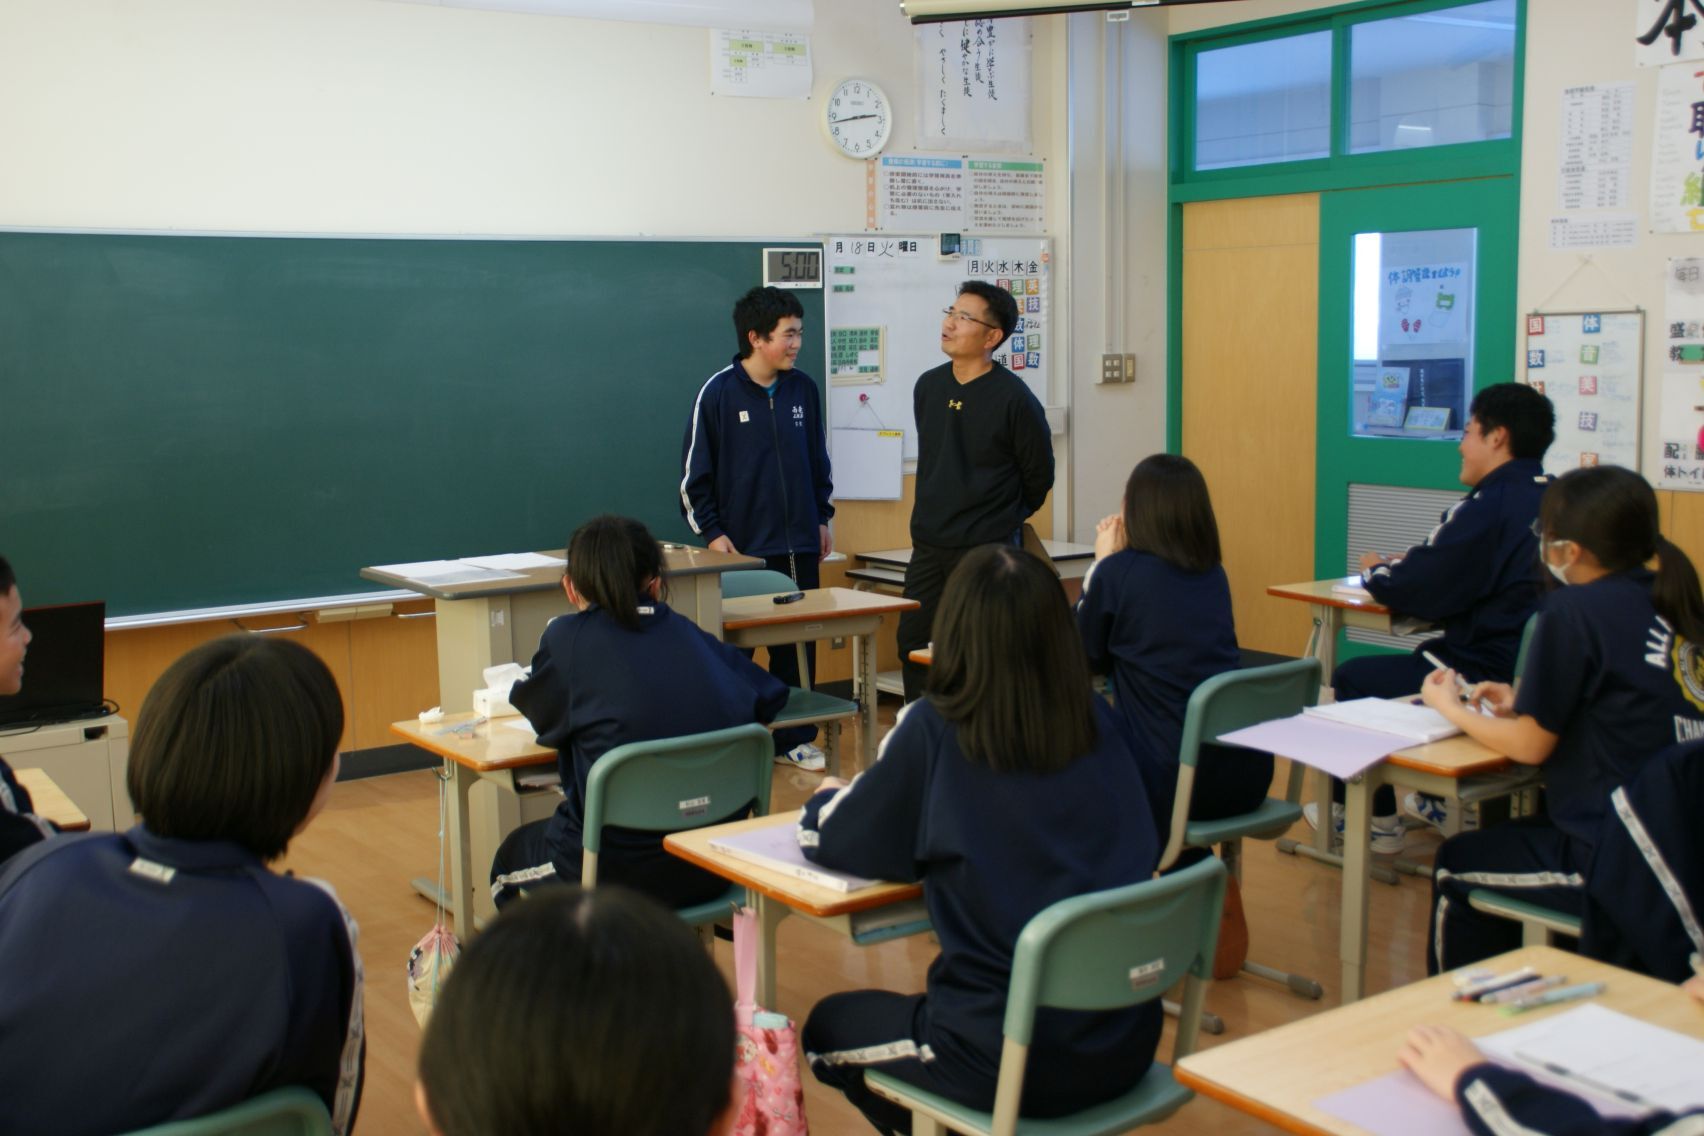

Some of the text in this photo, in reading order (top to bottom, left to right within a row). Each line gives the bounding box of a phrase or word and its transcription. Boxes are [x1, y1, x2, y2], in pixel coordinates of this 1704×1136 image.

[843, 89, 848, 97] 11
[854, 86, 861, 94] 12
[834, 98, 841, 107] 10
[834, 127, 840, 136] 8
[854, 143, 860, 151] 6
[866, 139, 872, 149] 5
[835, 240, 917, 257] 月 18 日 火 曜日
[970, 260, 1039, 274] 月 火 水 木 金
[1529, 317, 1543, 333] 国
[1584, 314, 1599, 332] 体
[1013, 336, 1024, 351] 体
[1013, 353, 1039, 368] 国 数
[1529, 350, 1543, 367] 数
[1580, 376, 1596, 394] 美
[1579, 412, 1596, 430] 技
[1663, 464, 1704, 480] 体トイ
